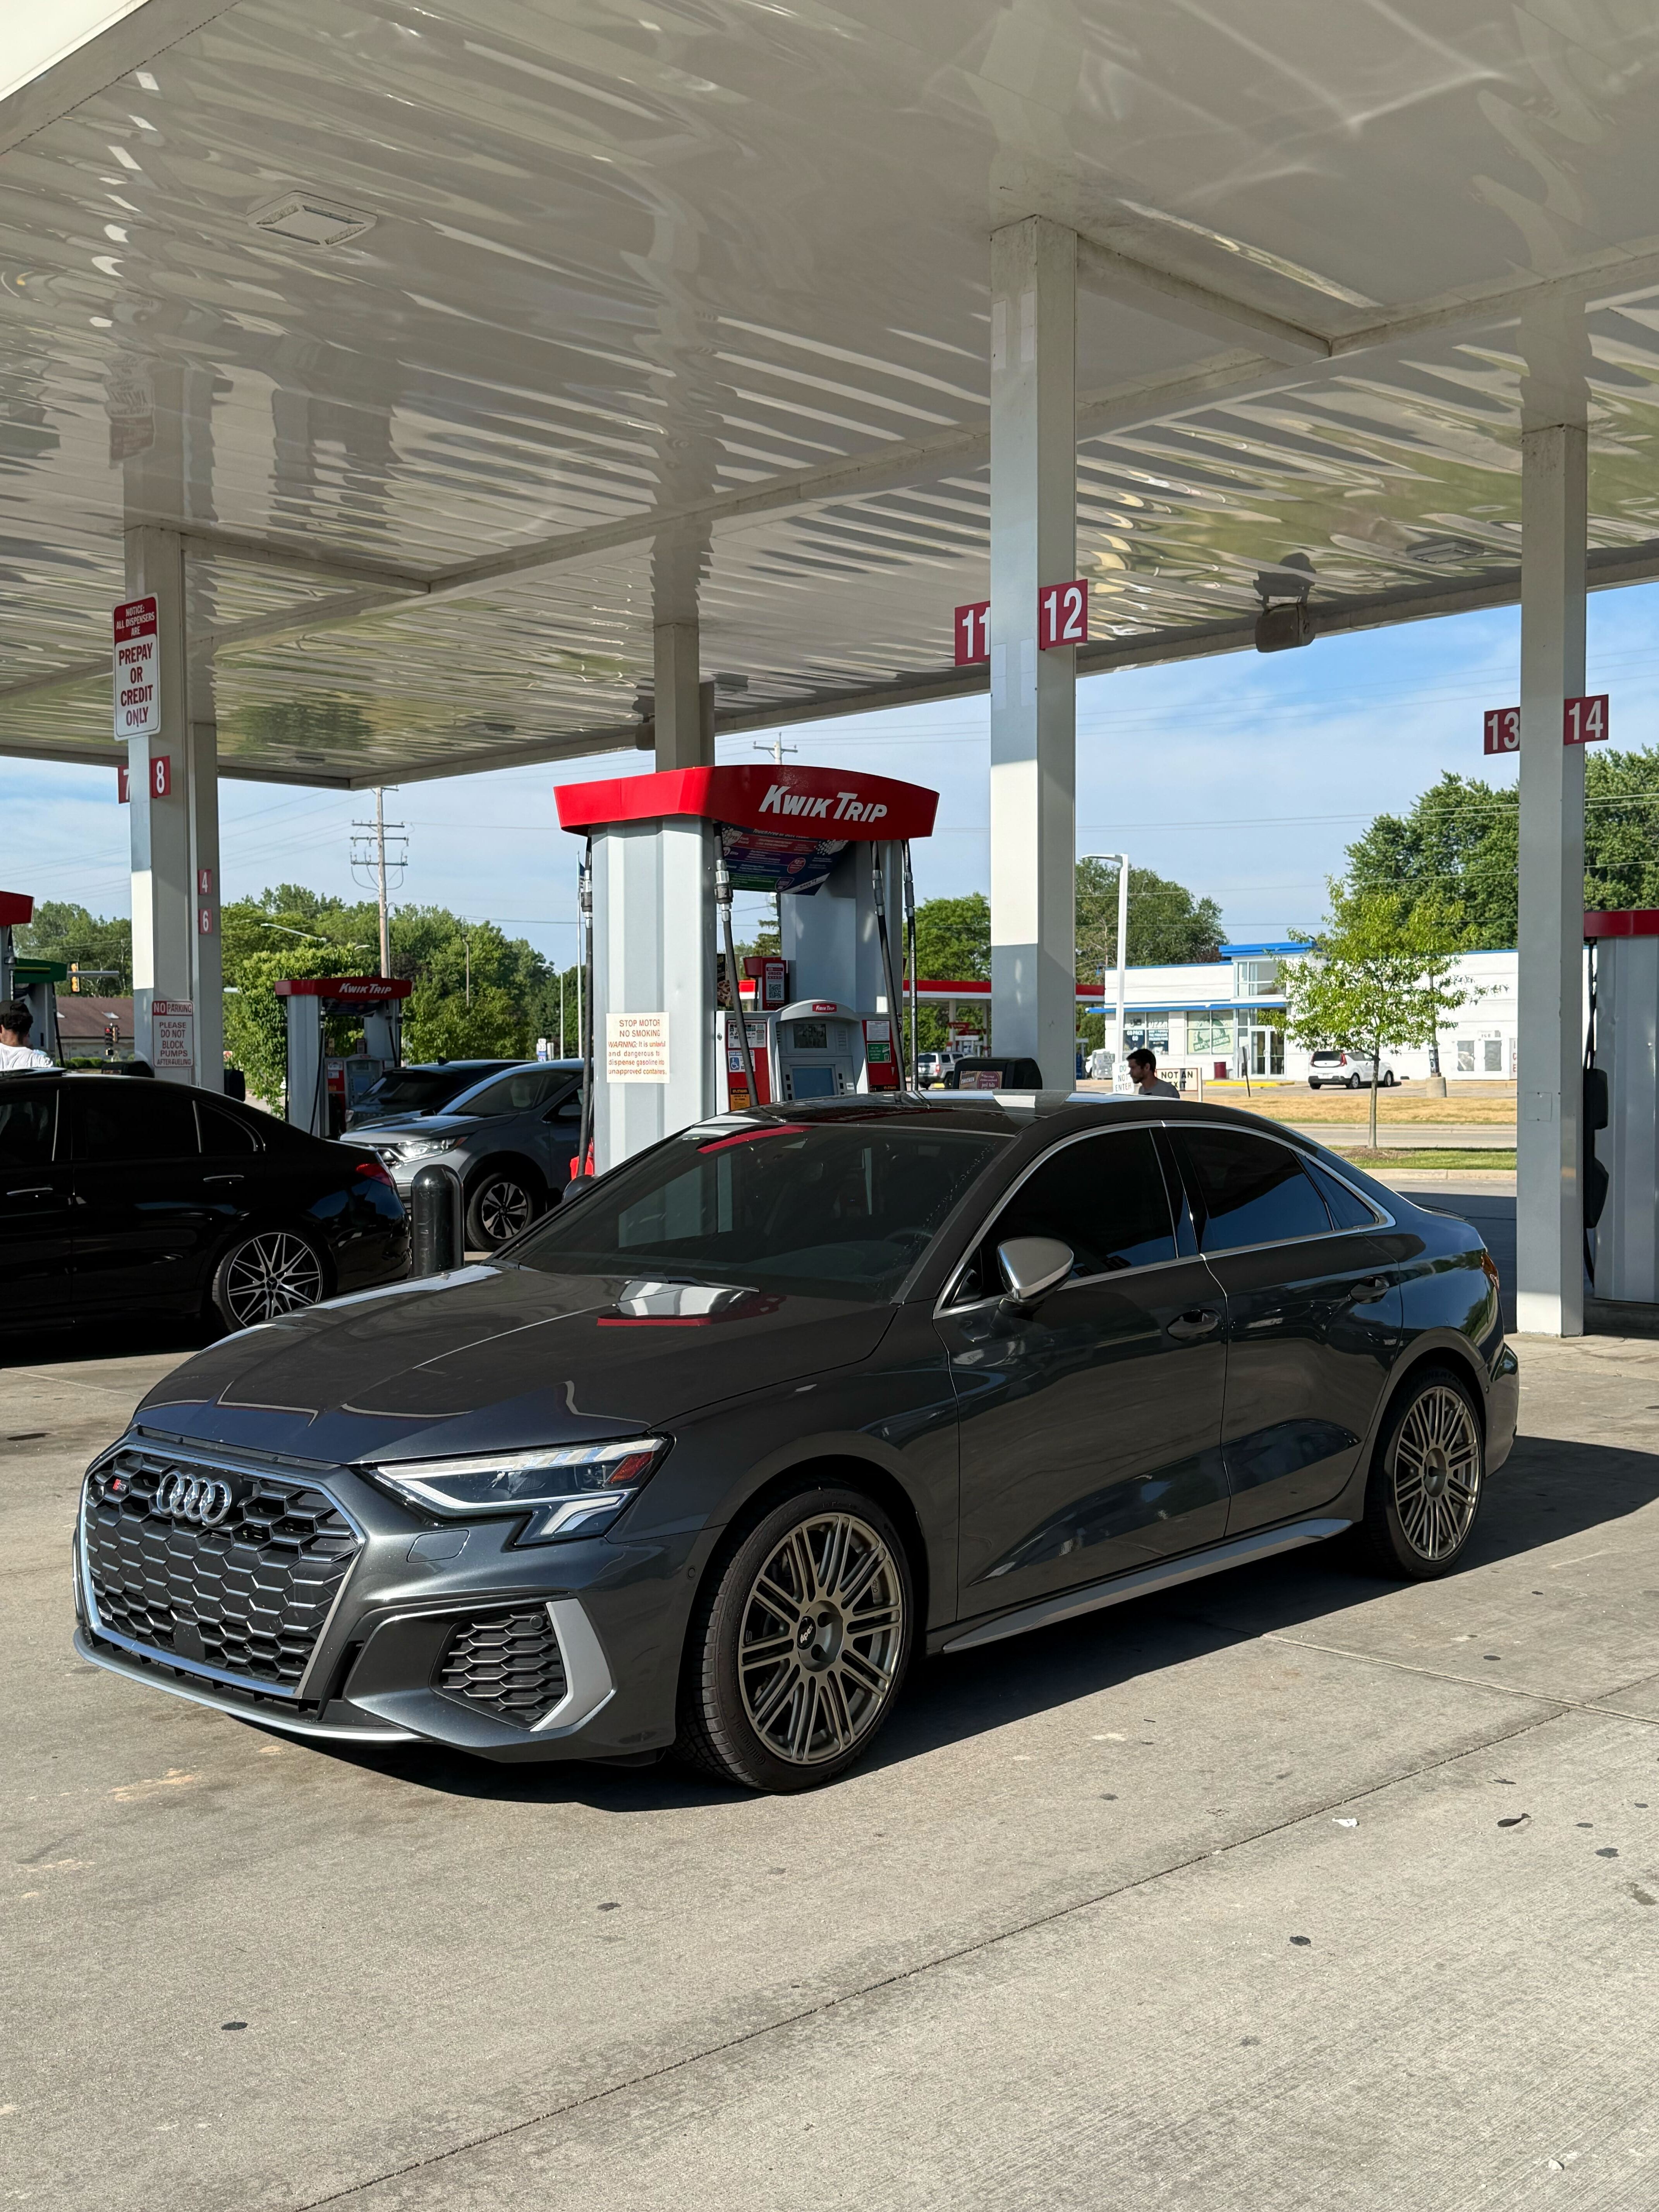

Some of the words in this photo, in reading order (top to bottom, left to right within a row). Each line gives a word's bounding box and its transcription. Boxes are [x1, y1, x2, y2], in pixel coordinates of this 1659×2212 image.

[117, 620, 125, 630] ALL
[126, 612, 155, 627] DISPENSERS
[126, 605, 144, 617] NOTICE:
[1044, 587, 1082, 642] 12
[131, 626, 140, 637] ARE
[962, 607, 990, 658] 11
[119, 642, 153, 666] PREPAY
[130, 666, 143, 684] OR
[120, 684, 153, 707] CREDIT
[126, 706, 149, 726] ONLY
[1569, 700, 1603, 740] 14
[1487, 711, 1520, 750] 13
[156, 761, 165, 793] 8
[202, 872, 208, 893] 4
[203, 910, 209, 932] 6
[154, 1003, 166, 1013] NO
[167, 1003, 192, 1013] PARKING
[161, 1029, 170, 1038] DO
[172, 1029, 185, 1038] NOT
[162, 1040, 184, 1049] BLOCK
[608, 1068, 642, 1076] unapproved
[1118, 1074, 1129, 1082] NOT
[1115, 1082, 1132, 1092] ENTER
[800, 1624, 813, 1644] Apex
